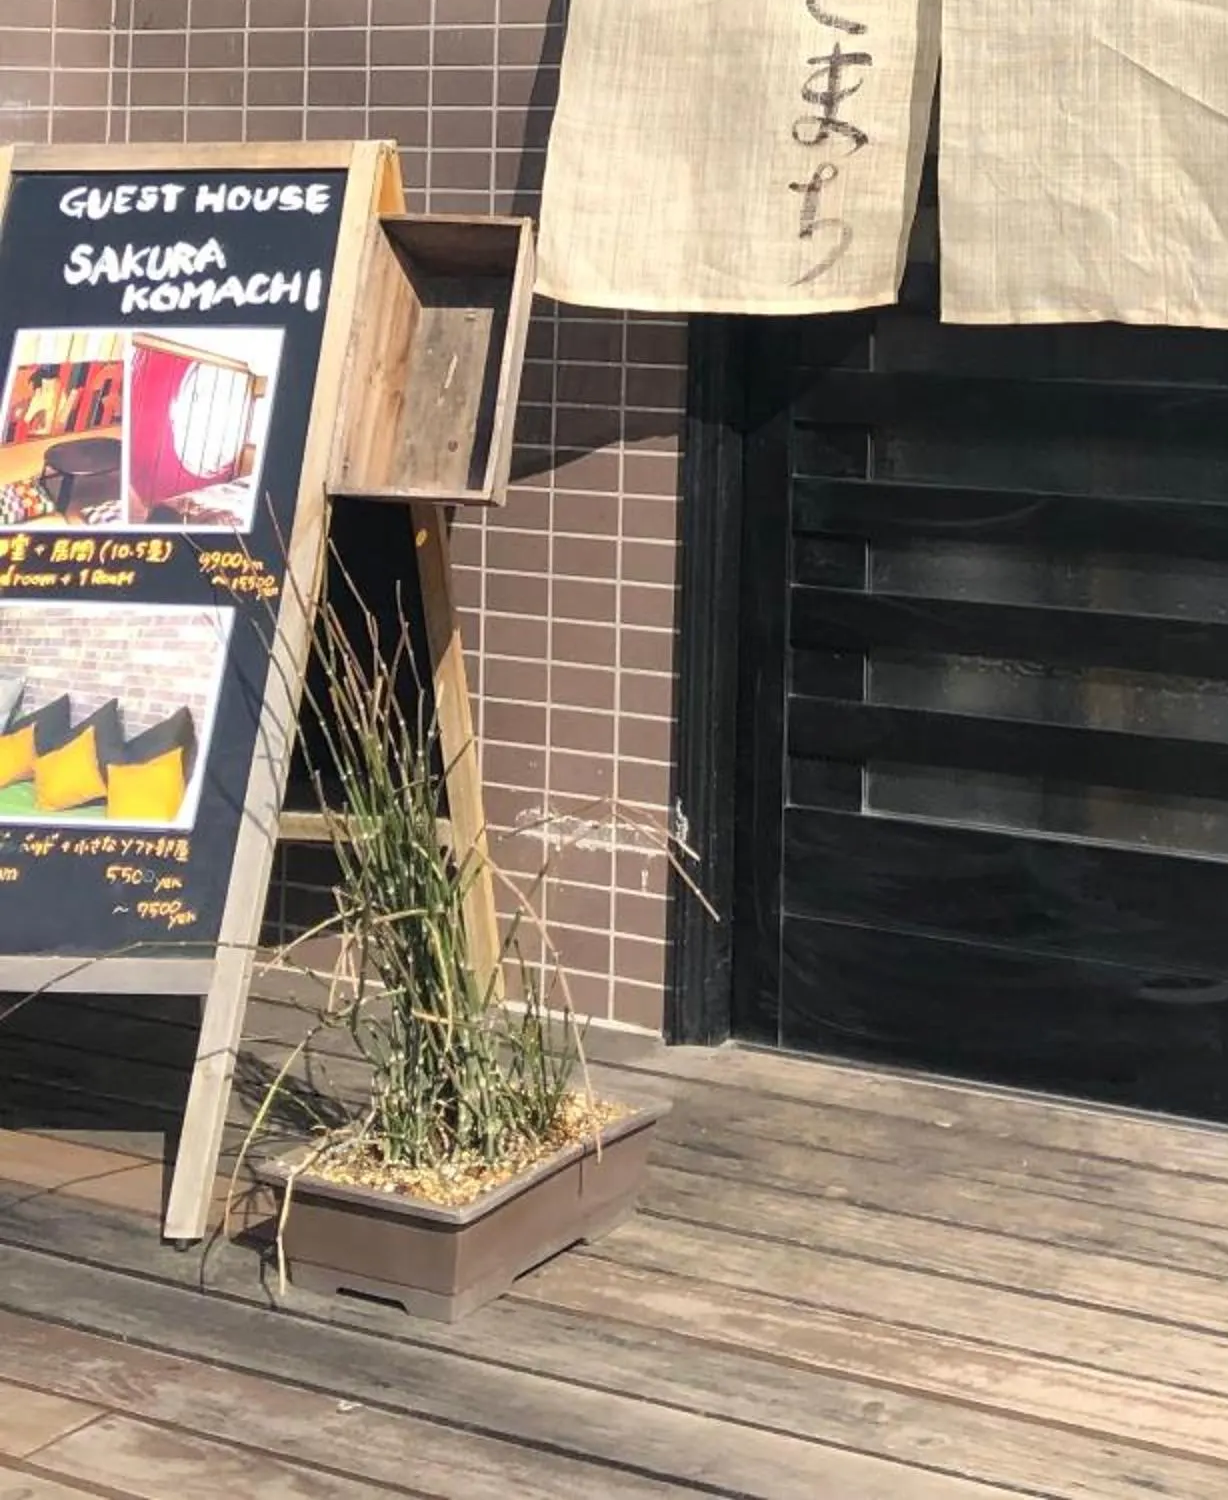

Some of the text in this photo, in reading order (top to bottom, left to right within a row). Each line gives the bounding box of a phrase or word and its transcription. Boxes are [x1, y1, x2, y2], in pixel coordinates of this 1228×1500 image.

[59, 182, 331, 220] GUEST HOUSE
[63, 237, 228, 286] SAKURA
[121, 267, 323, 313] KOMACHI
